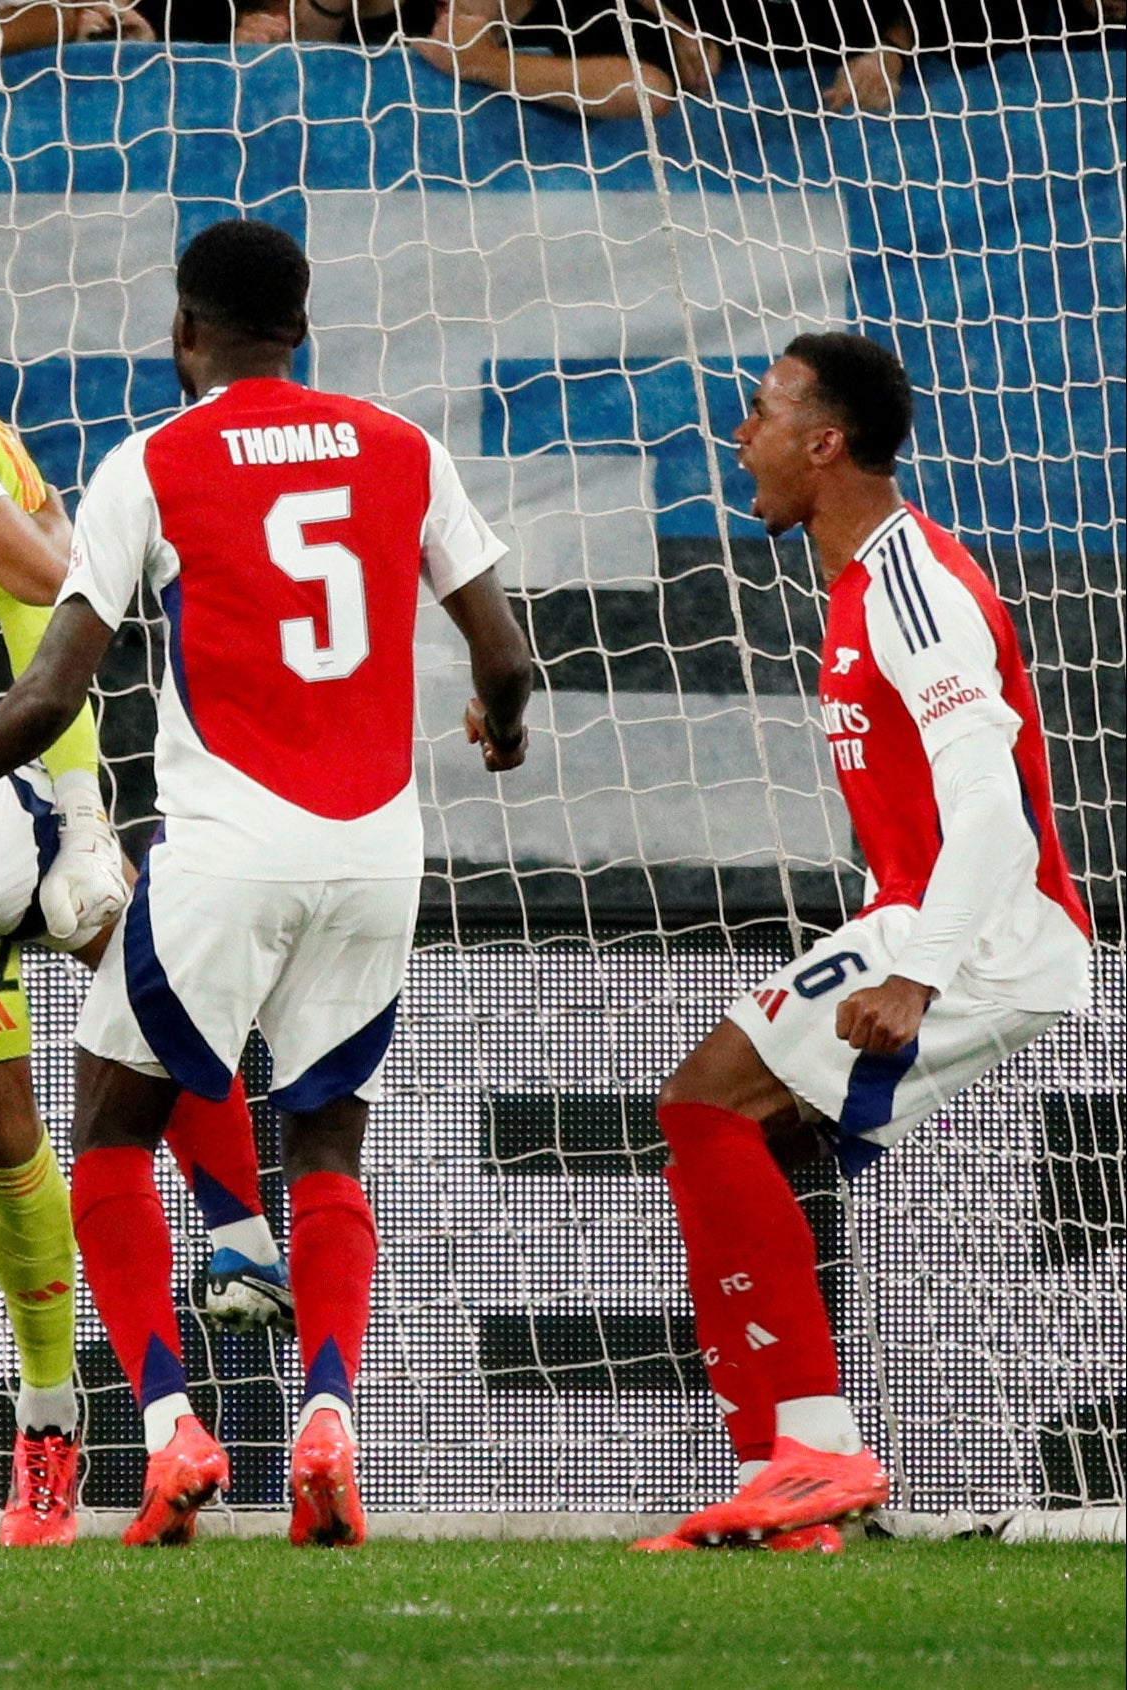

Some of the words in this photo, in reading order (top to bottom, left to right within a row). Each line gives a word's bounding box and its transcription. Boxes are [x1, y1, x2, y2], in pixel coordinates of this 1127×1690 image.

[220, 422, 361, 466] THOMAS
[262, 485, 371, 684] 5
[917, 674, 961, 704] VISIT
[792, 951, 869, 1000] 6
[719, 1271, 754, 1296] FC
